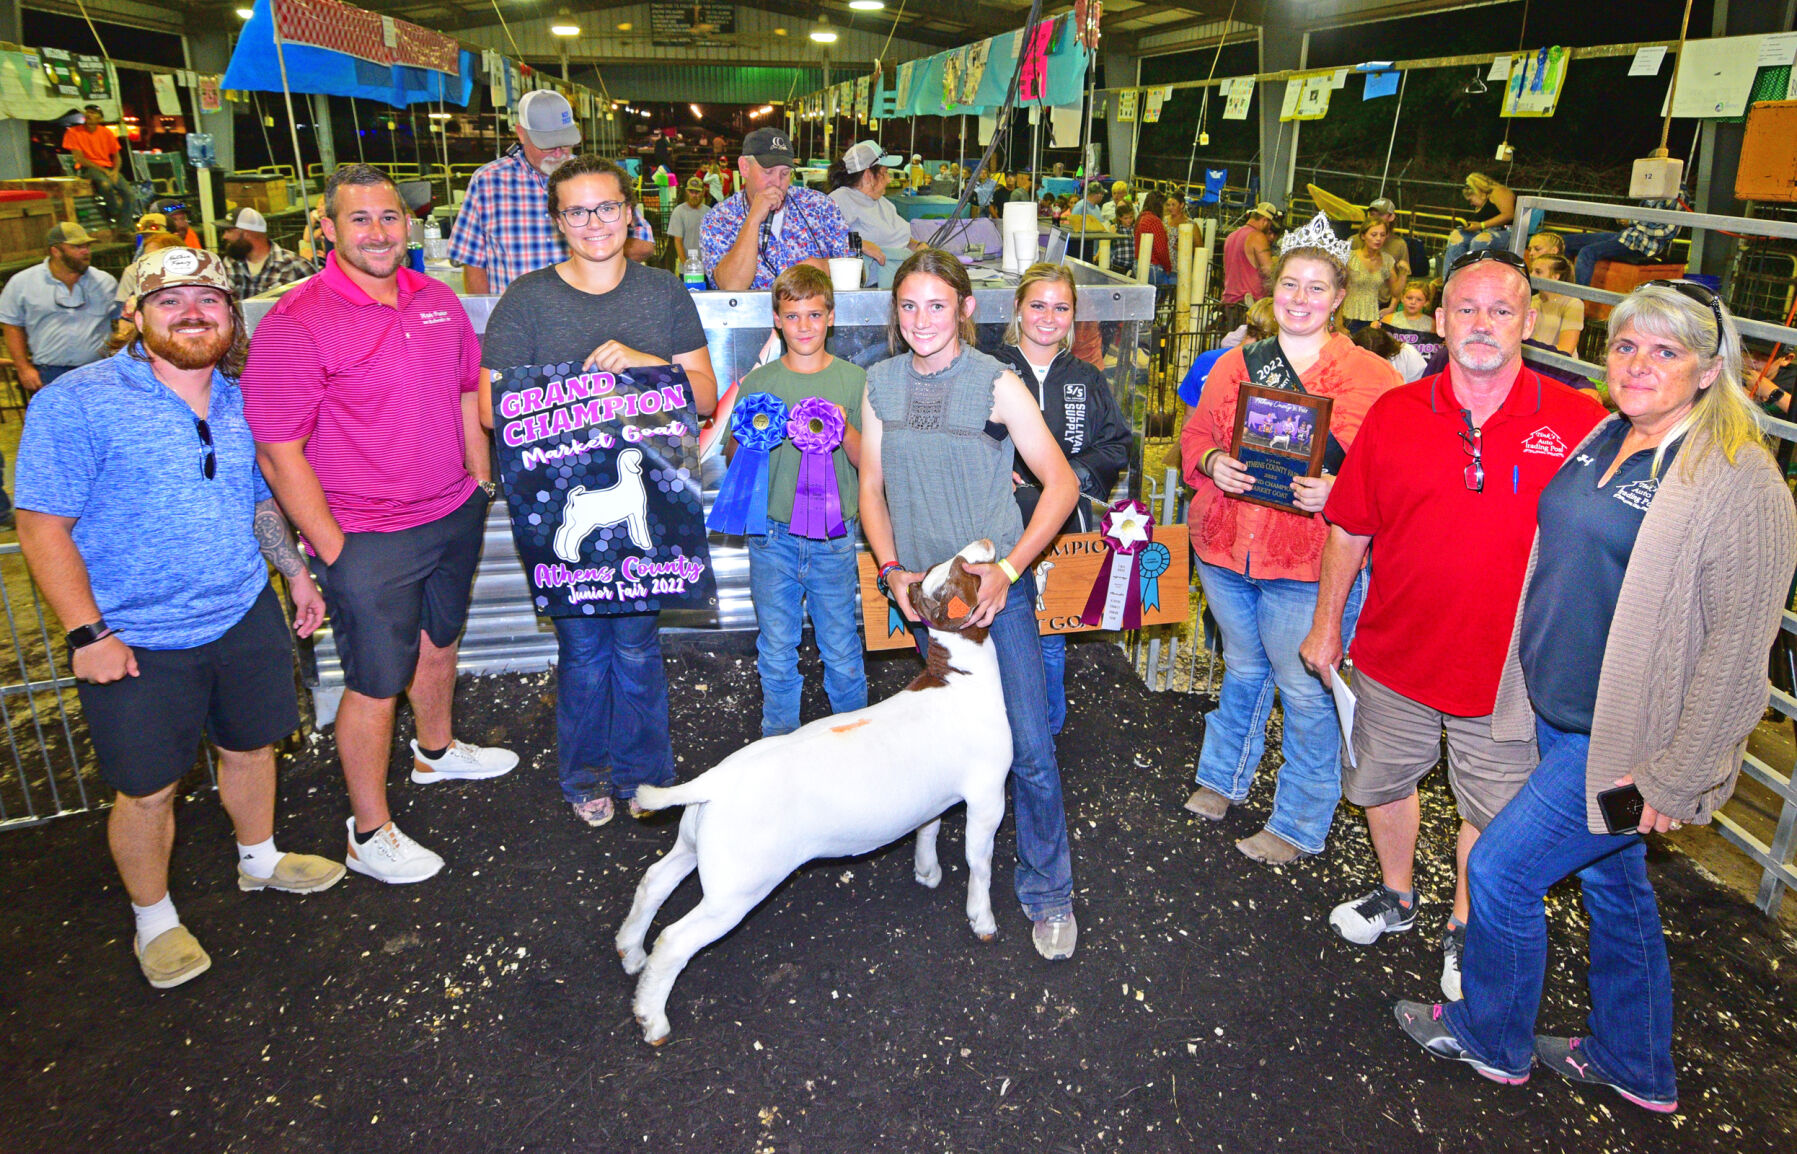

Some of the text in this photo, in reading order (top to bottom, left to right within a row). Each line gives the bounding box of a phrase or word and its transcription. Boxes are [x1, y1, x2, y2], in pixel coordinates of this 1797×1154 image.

[1256, 357, 1285, 380] 2022
[501, 371, 616, 419] GRAND
[503, 383, 687, 448] CHAMPION
[1064, 403, 1076, 443] SUPPLY
[1070, 403, 1086, 454] SULLIVAN
[521, 420, 688, 469] Market Goat
[1550, 445, 1564, 453] Post
[1265, 463, 1288, 475] COUNTY
[1272, 489, 1288, 499] GOAT
[1631, 488, 1652, 498] Auto
[534, 554, 705, 589] Athens County
[567, 577, 687, 605] Junior Fair 2022
